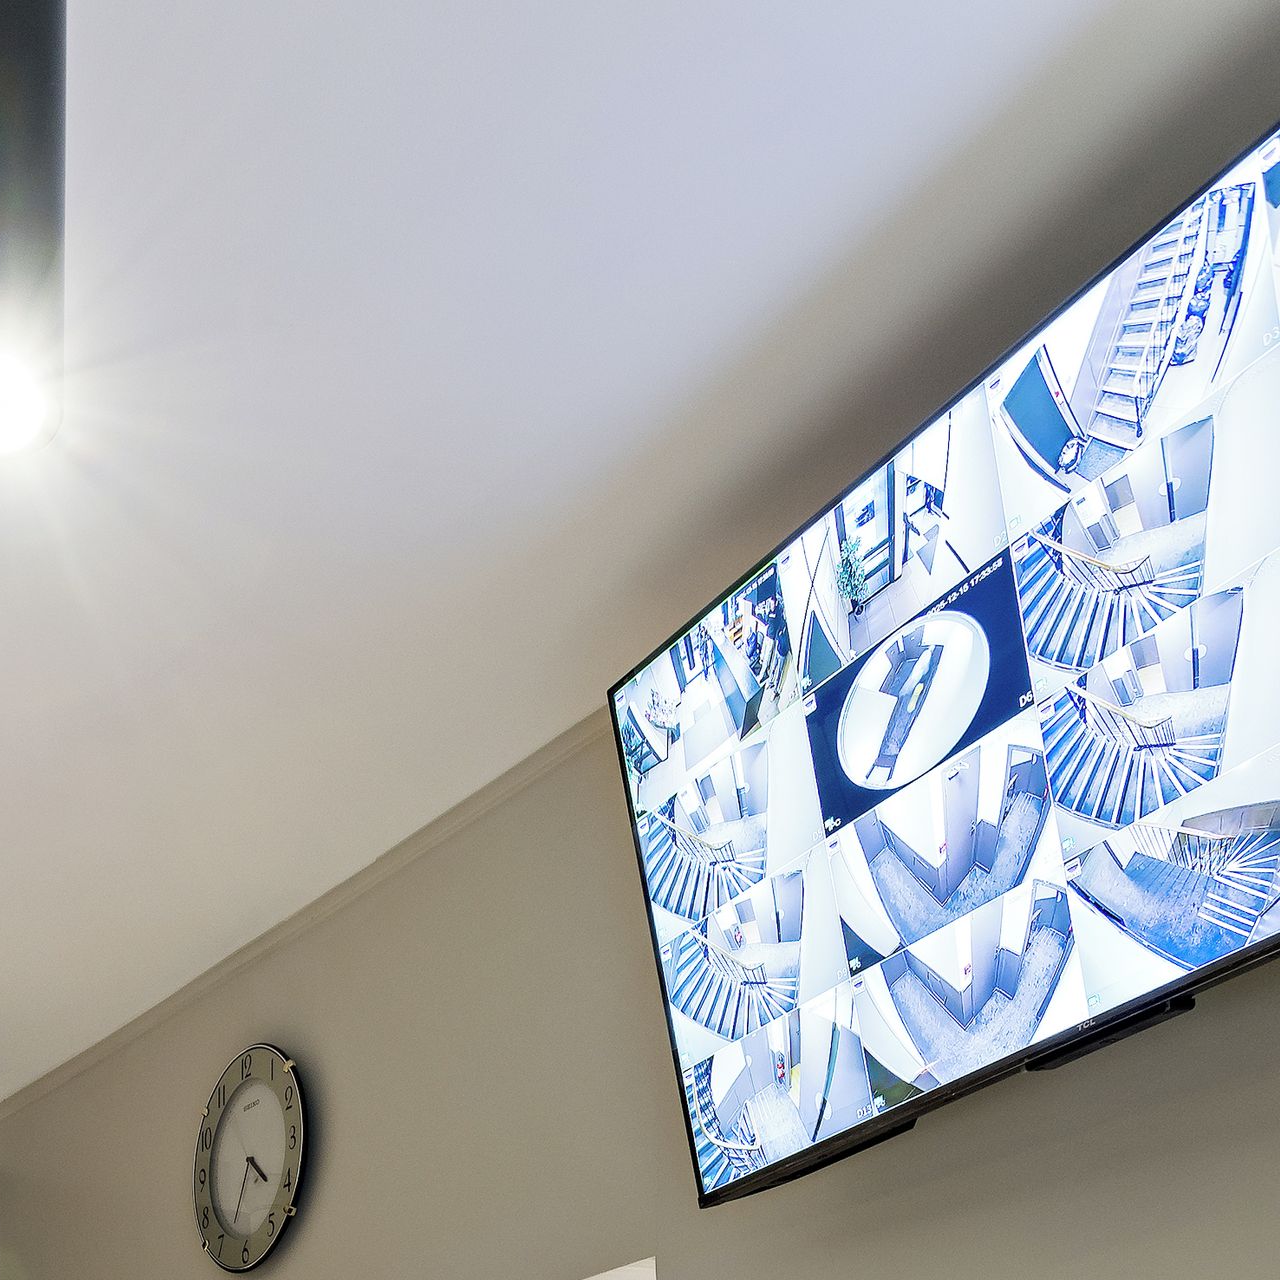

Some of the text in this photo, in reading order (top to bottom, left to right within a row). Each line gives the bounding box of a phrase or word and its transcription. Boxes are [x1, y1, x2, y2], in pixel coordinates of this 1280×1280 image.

[1019, 690, 1034, 709] D6
[1077, 1019, 1096, 1032] TCL
[240, 1054, 252, 1080] 12
[270, 1057, 275, 1081] 1
[216, 1084, 226, 1108] 11
[243, 1098, 261, 1112] SEIKO
[284, 1085, 293, 1111] 2
[201, 1127, 212, 1152] 10
[288, 1125, 297, 1150] 3
[198, 1168, 207, 1192] 9
[283, 1167, 292, 1192] 4
[201, 1206, 210, 1229] 8
[267, 1212, 275, 1237] 5
[217, 1234, 225, 1259] 7
[241, 1239, 250, 1265] 6
